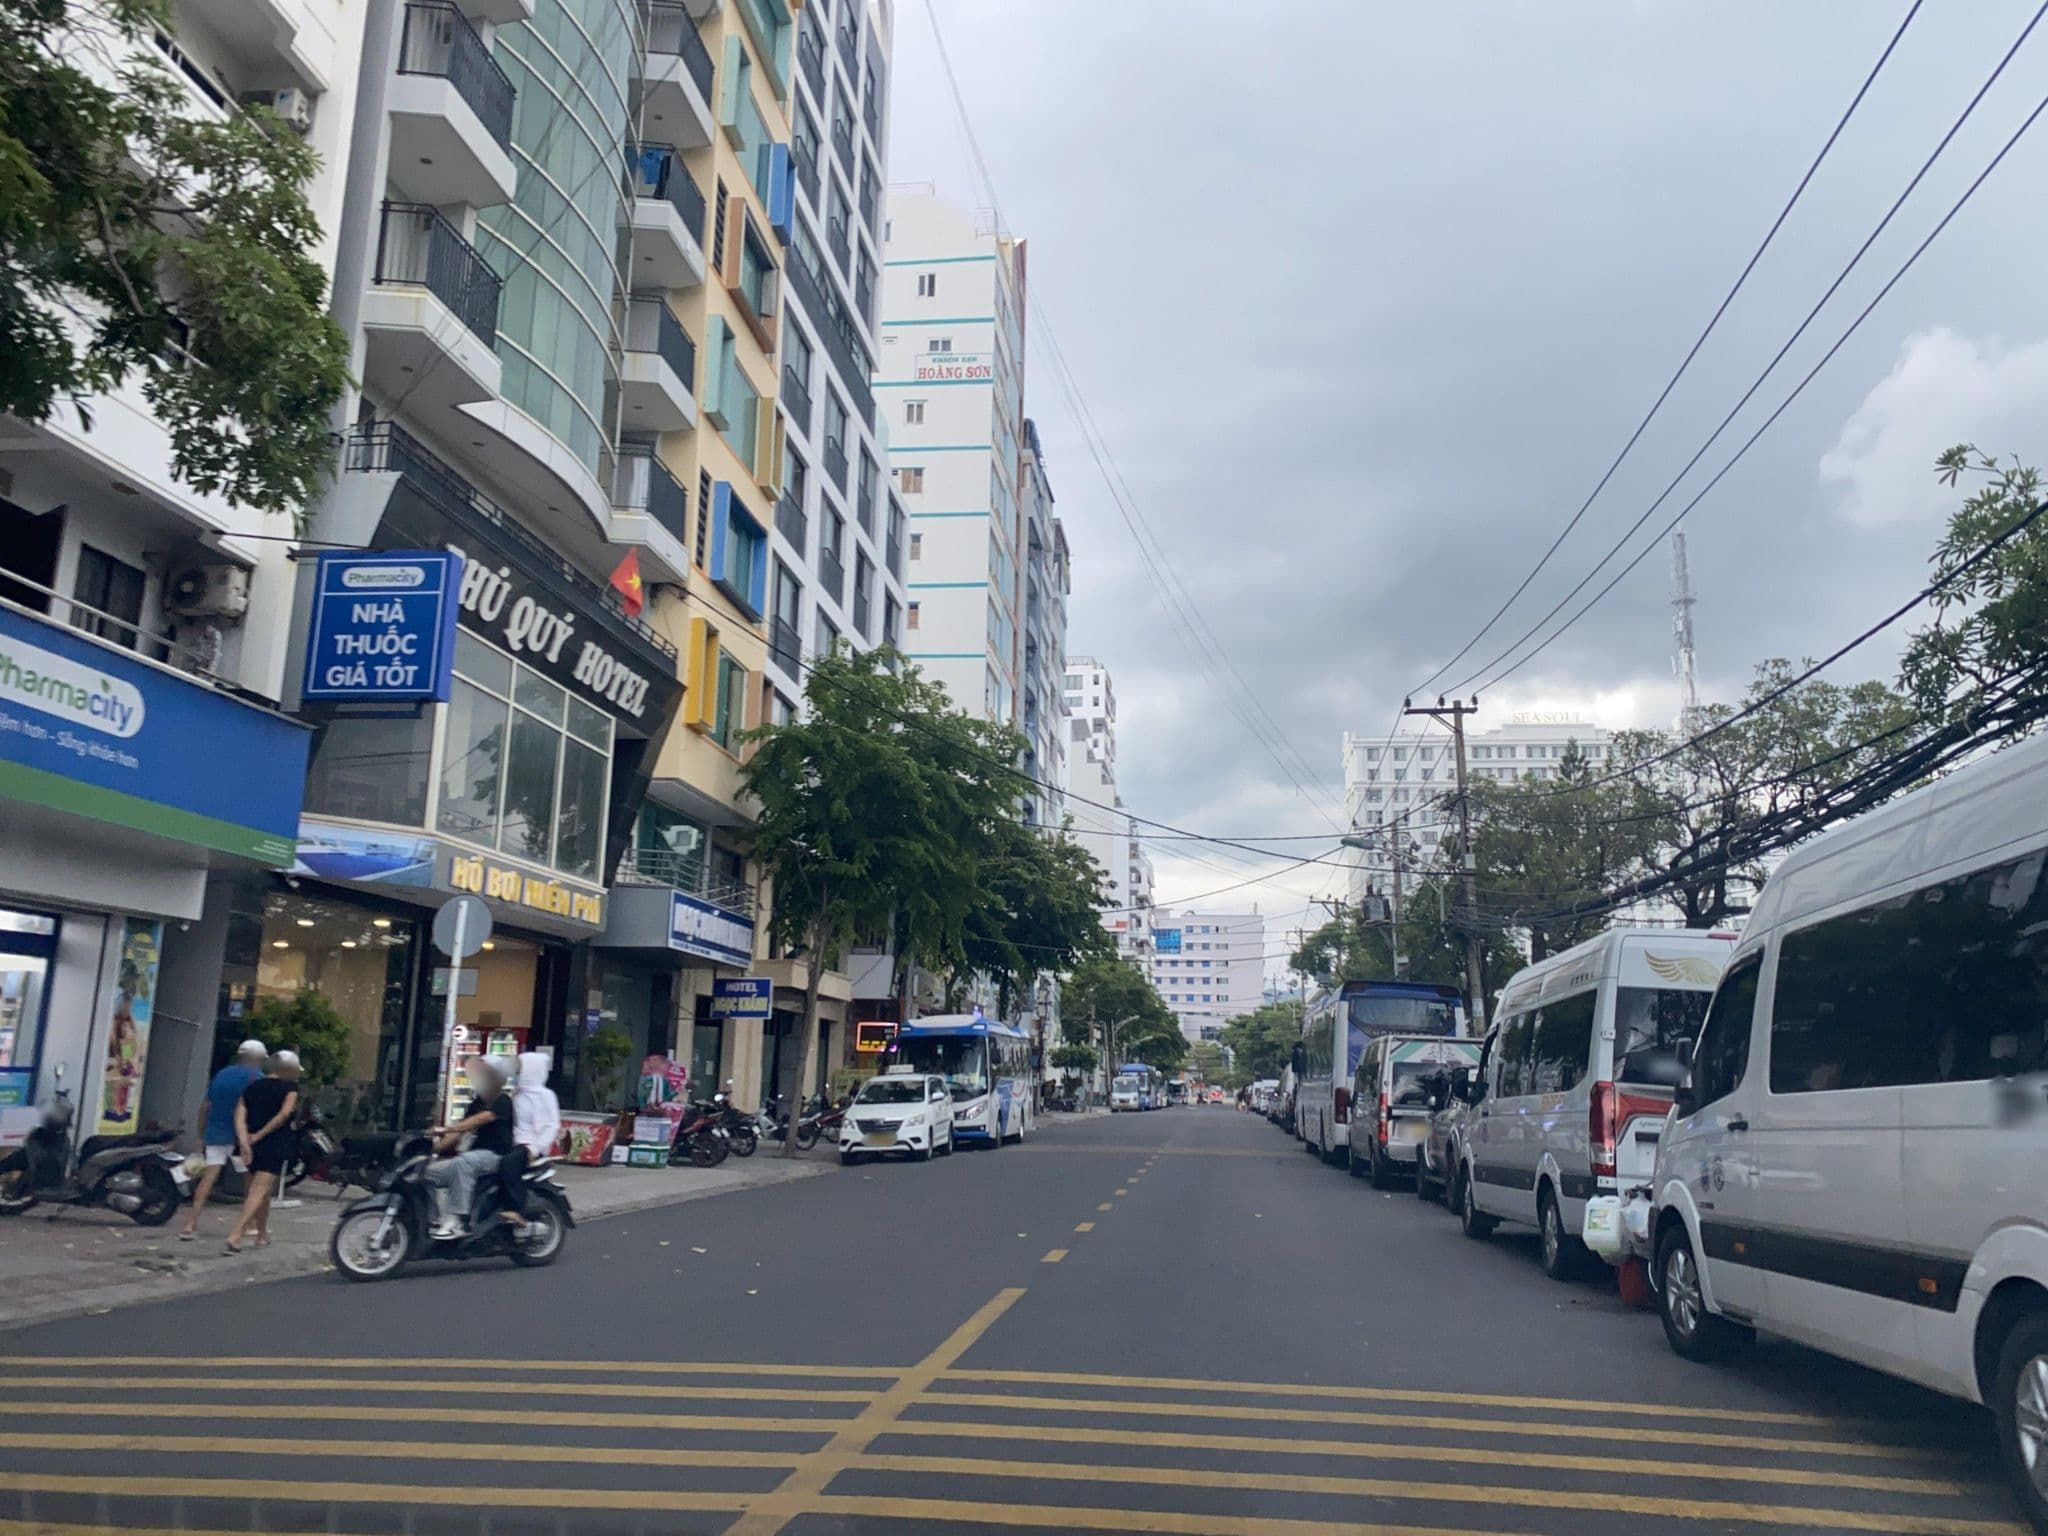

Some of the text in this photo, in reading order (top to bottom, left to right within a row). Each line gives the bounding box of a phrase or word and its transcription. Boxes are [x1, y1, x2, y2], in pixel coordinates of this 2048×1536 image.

[918, 365, 991, 379] HOÀNG SƠN
[351, 597, 405, 624] NHÀ
[334, 624, 418, 655] THUỐC
[446, 543, 650, 718] HÚ QUÝ HOTEL
[326, 656, 419, 687] GIÁ TỐT
[725, 982, 758, 993] HOTEL
